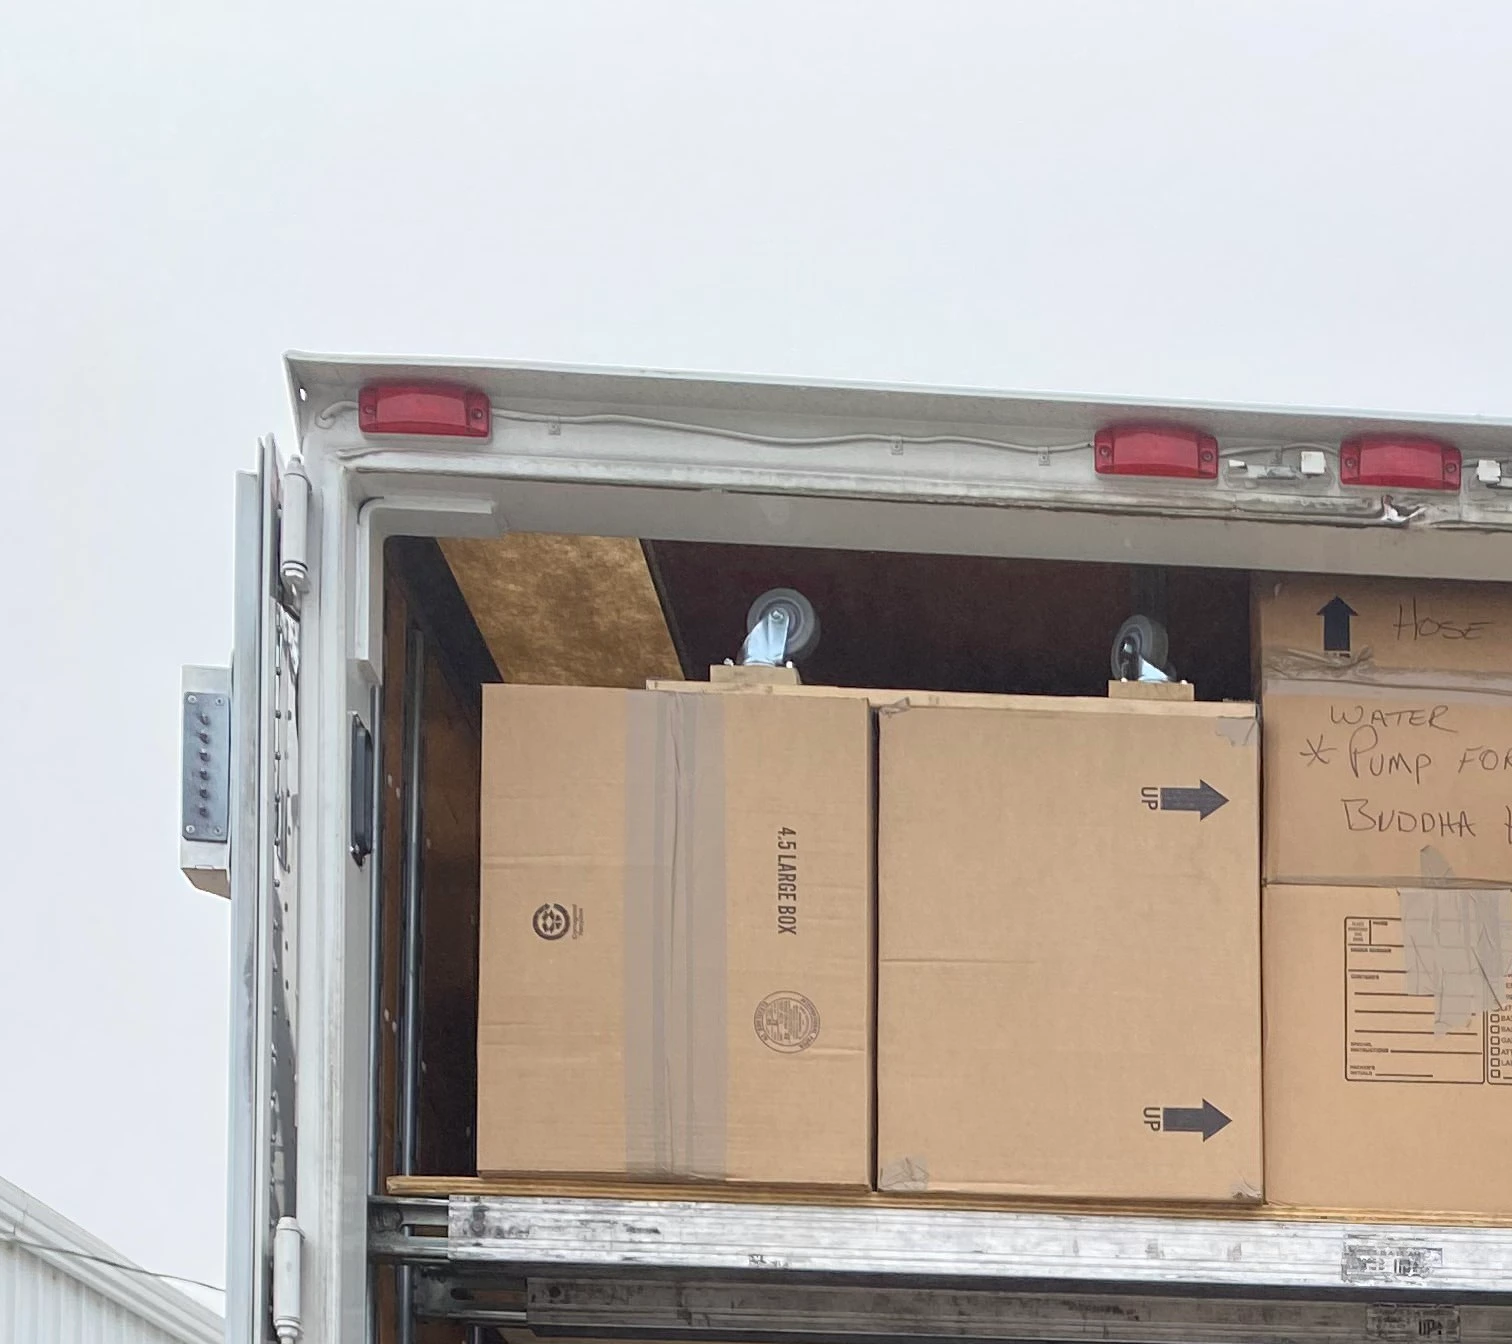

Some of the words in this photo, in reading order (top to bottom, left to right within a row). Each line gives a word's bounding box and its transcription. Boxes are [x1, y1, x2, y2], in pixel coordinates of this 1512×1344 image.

[1330, 703, 1459, 734] WATER
[1140, 786, 1158, 810] UP
[777, 826, 797, 850] 4.5
[777, 854, 797, 901] LARGE
[777, 905, 797, 936] BOX
[1143, 1107, 1161, 1132] UP
